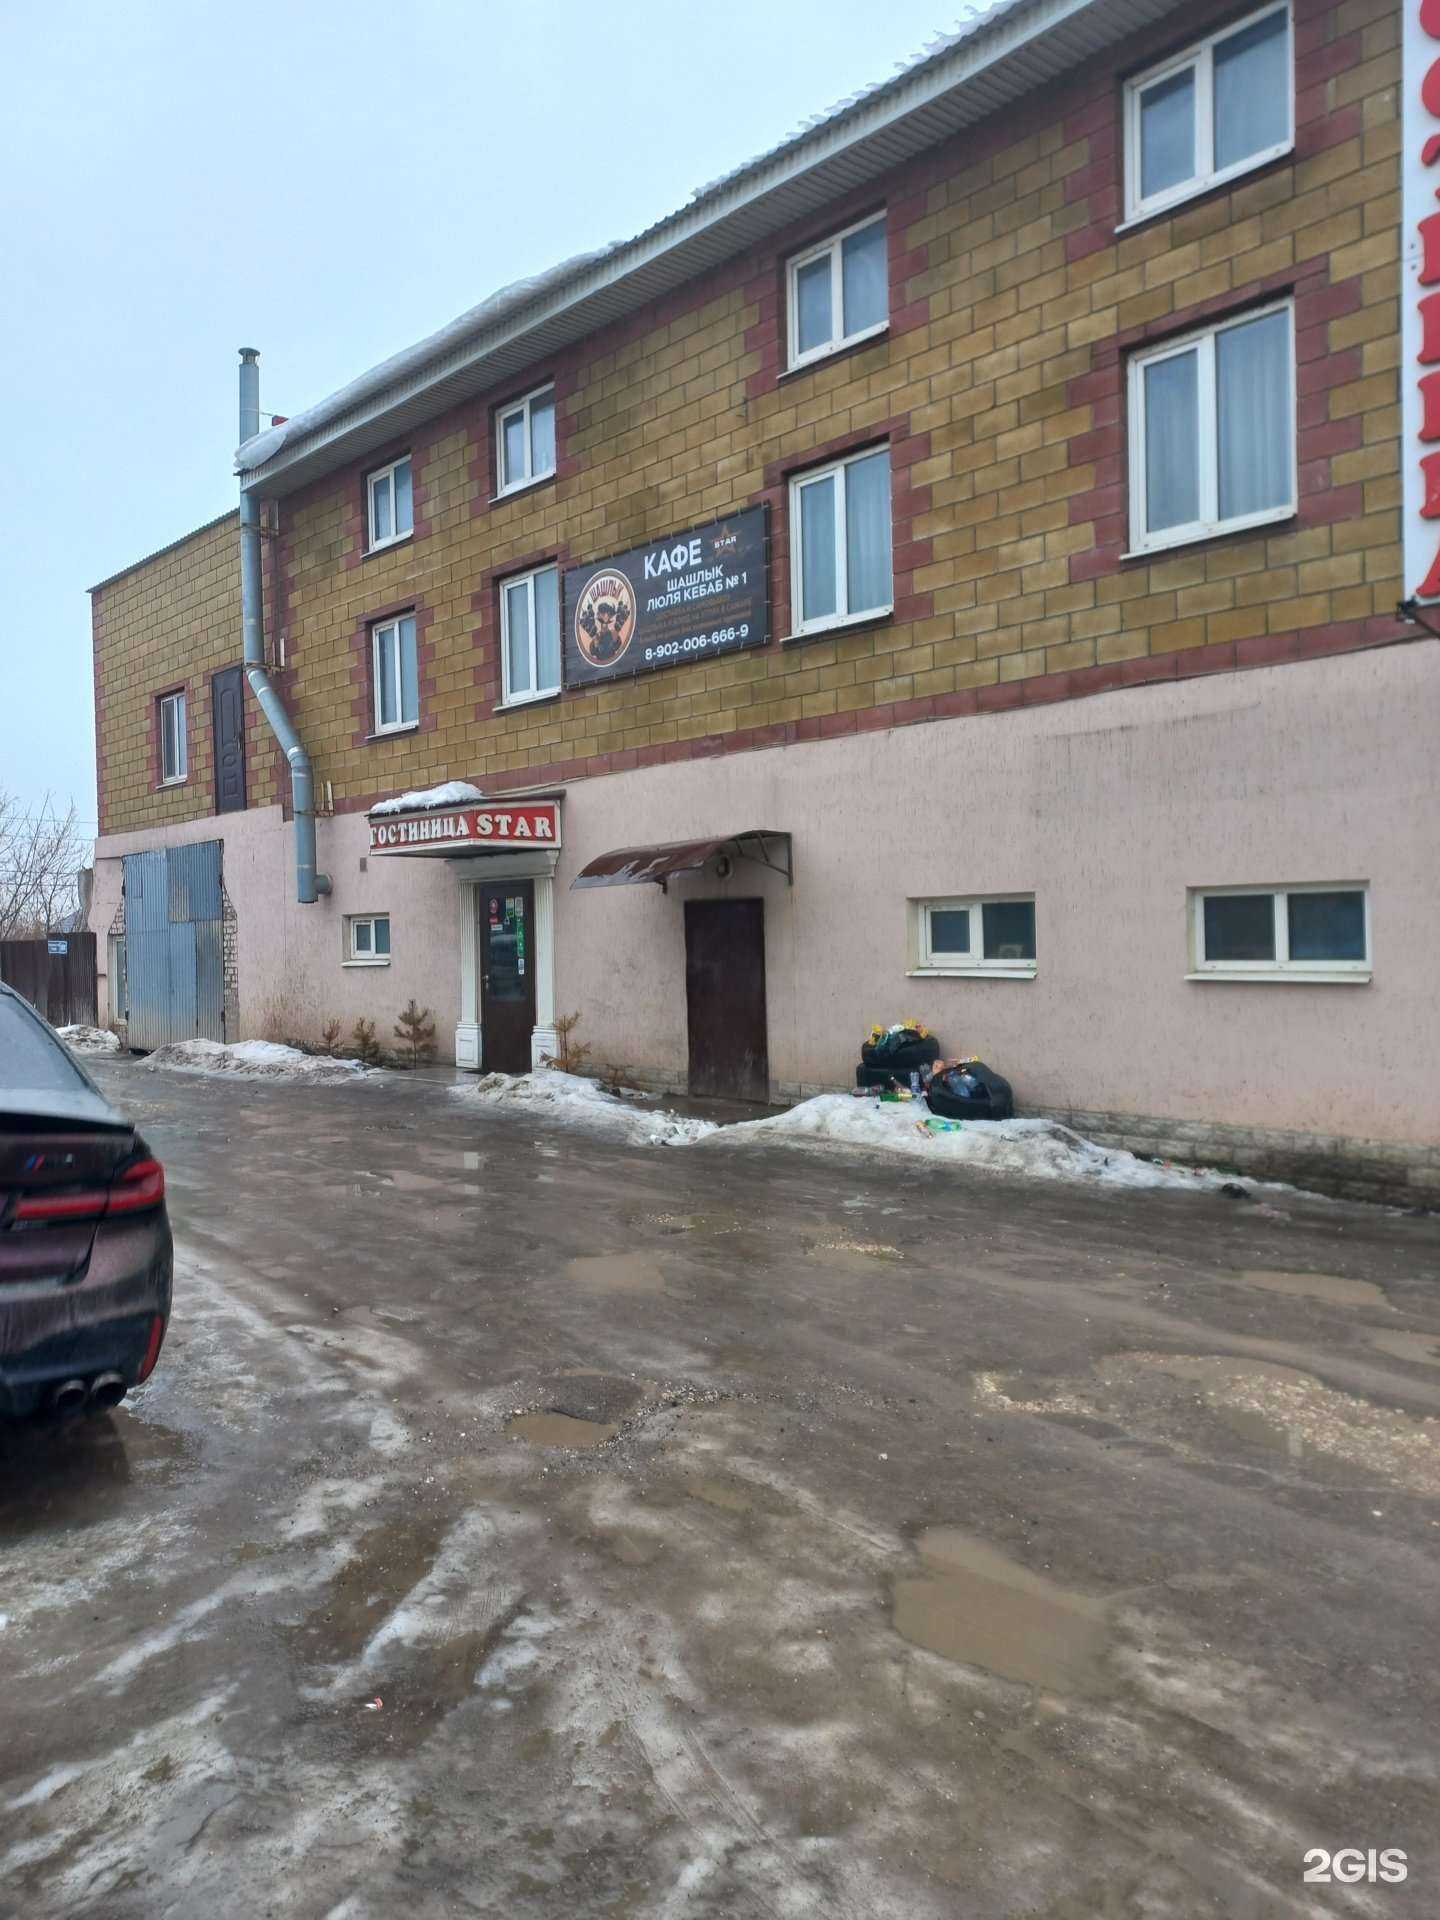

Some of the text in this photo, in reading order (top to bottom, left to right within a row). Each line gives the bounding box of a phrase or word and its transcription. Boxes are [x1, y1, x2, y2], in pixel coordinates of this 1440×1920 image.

[643, 538, 702, 580] КАФЕ
[646, 591, 681, 612] ЛЮЛЯ
[683, 579, 724, 601] КЕБАБ
[725, 574, 739, 589] №
[741, 571, 748, 584] 1
[666, 564, 724, 592] ШАШЛЫК
[644, 623, 749, 661] 8-902-006-666-9
[369, 815, 470, 847] ГОСТИНИЦА
[476, 813, 553, 838] STAR
